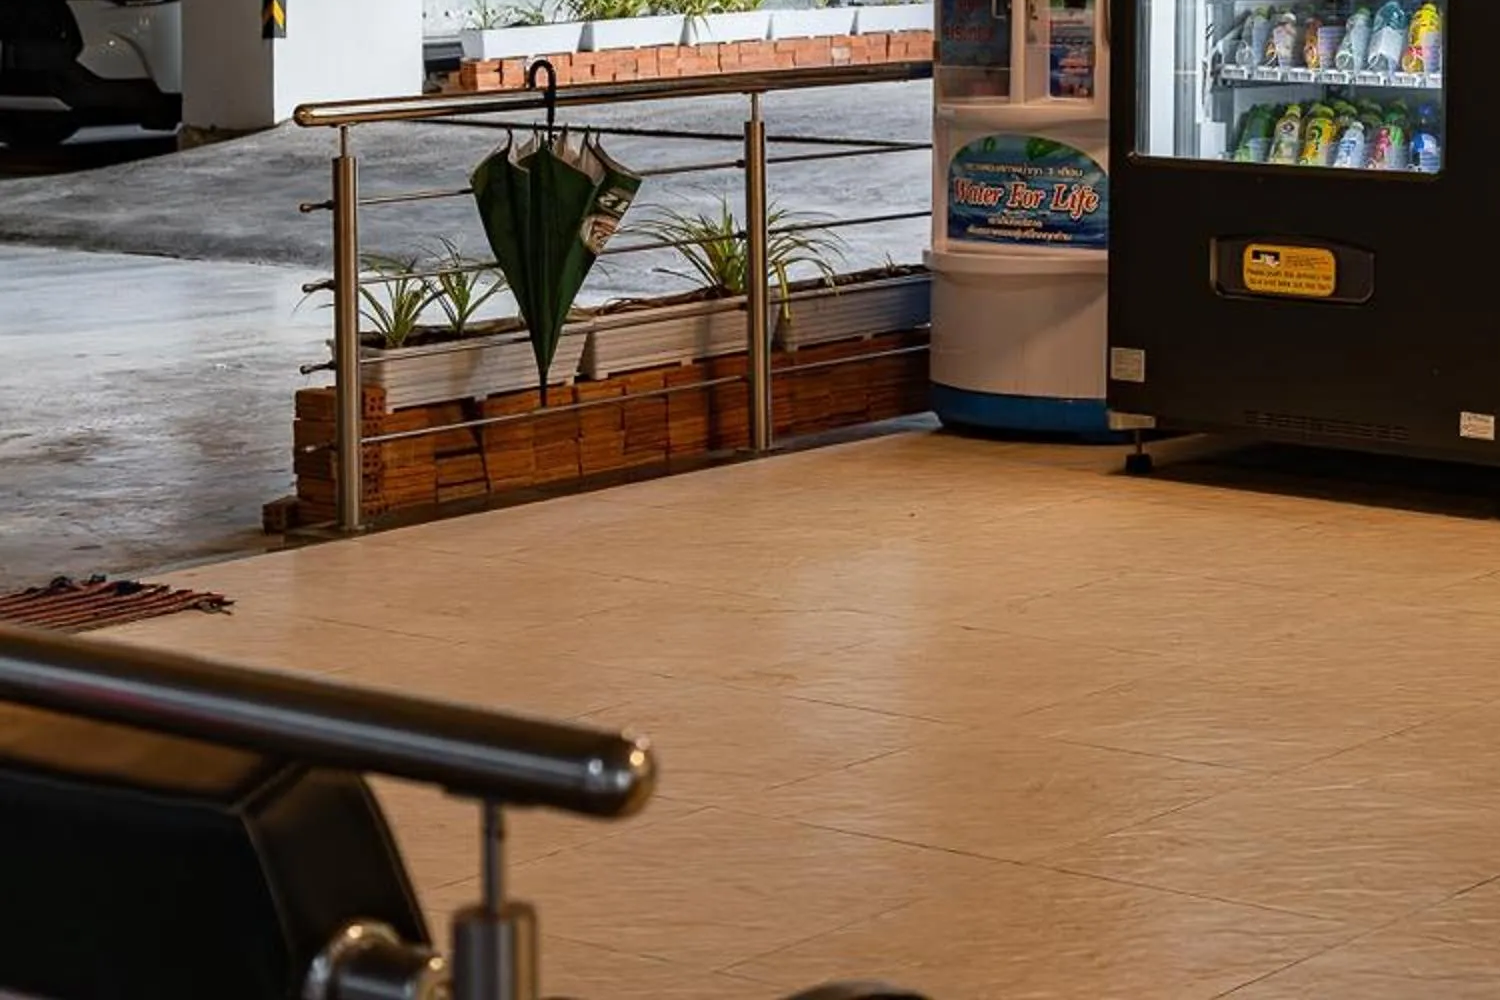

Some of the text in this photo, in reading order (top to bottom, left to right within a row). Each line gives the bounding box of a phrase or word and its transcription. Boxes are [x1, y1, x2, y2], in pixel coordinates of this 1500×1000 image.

[953, 177, 1099, 220] Water For Life
